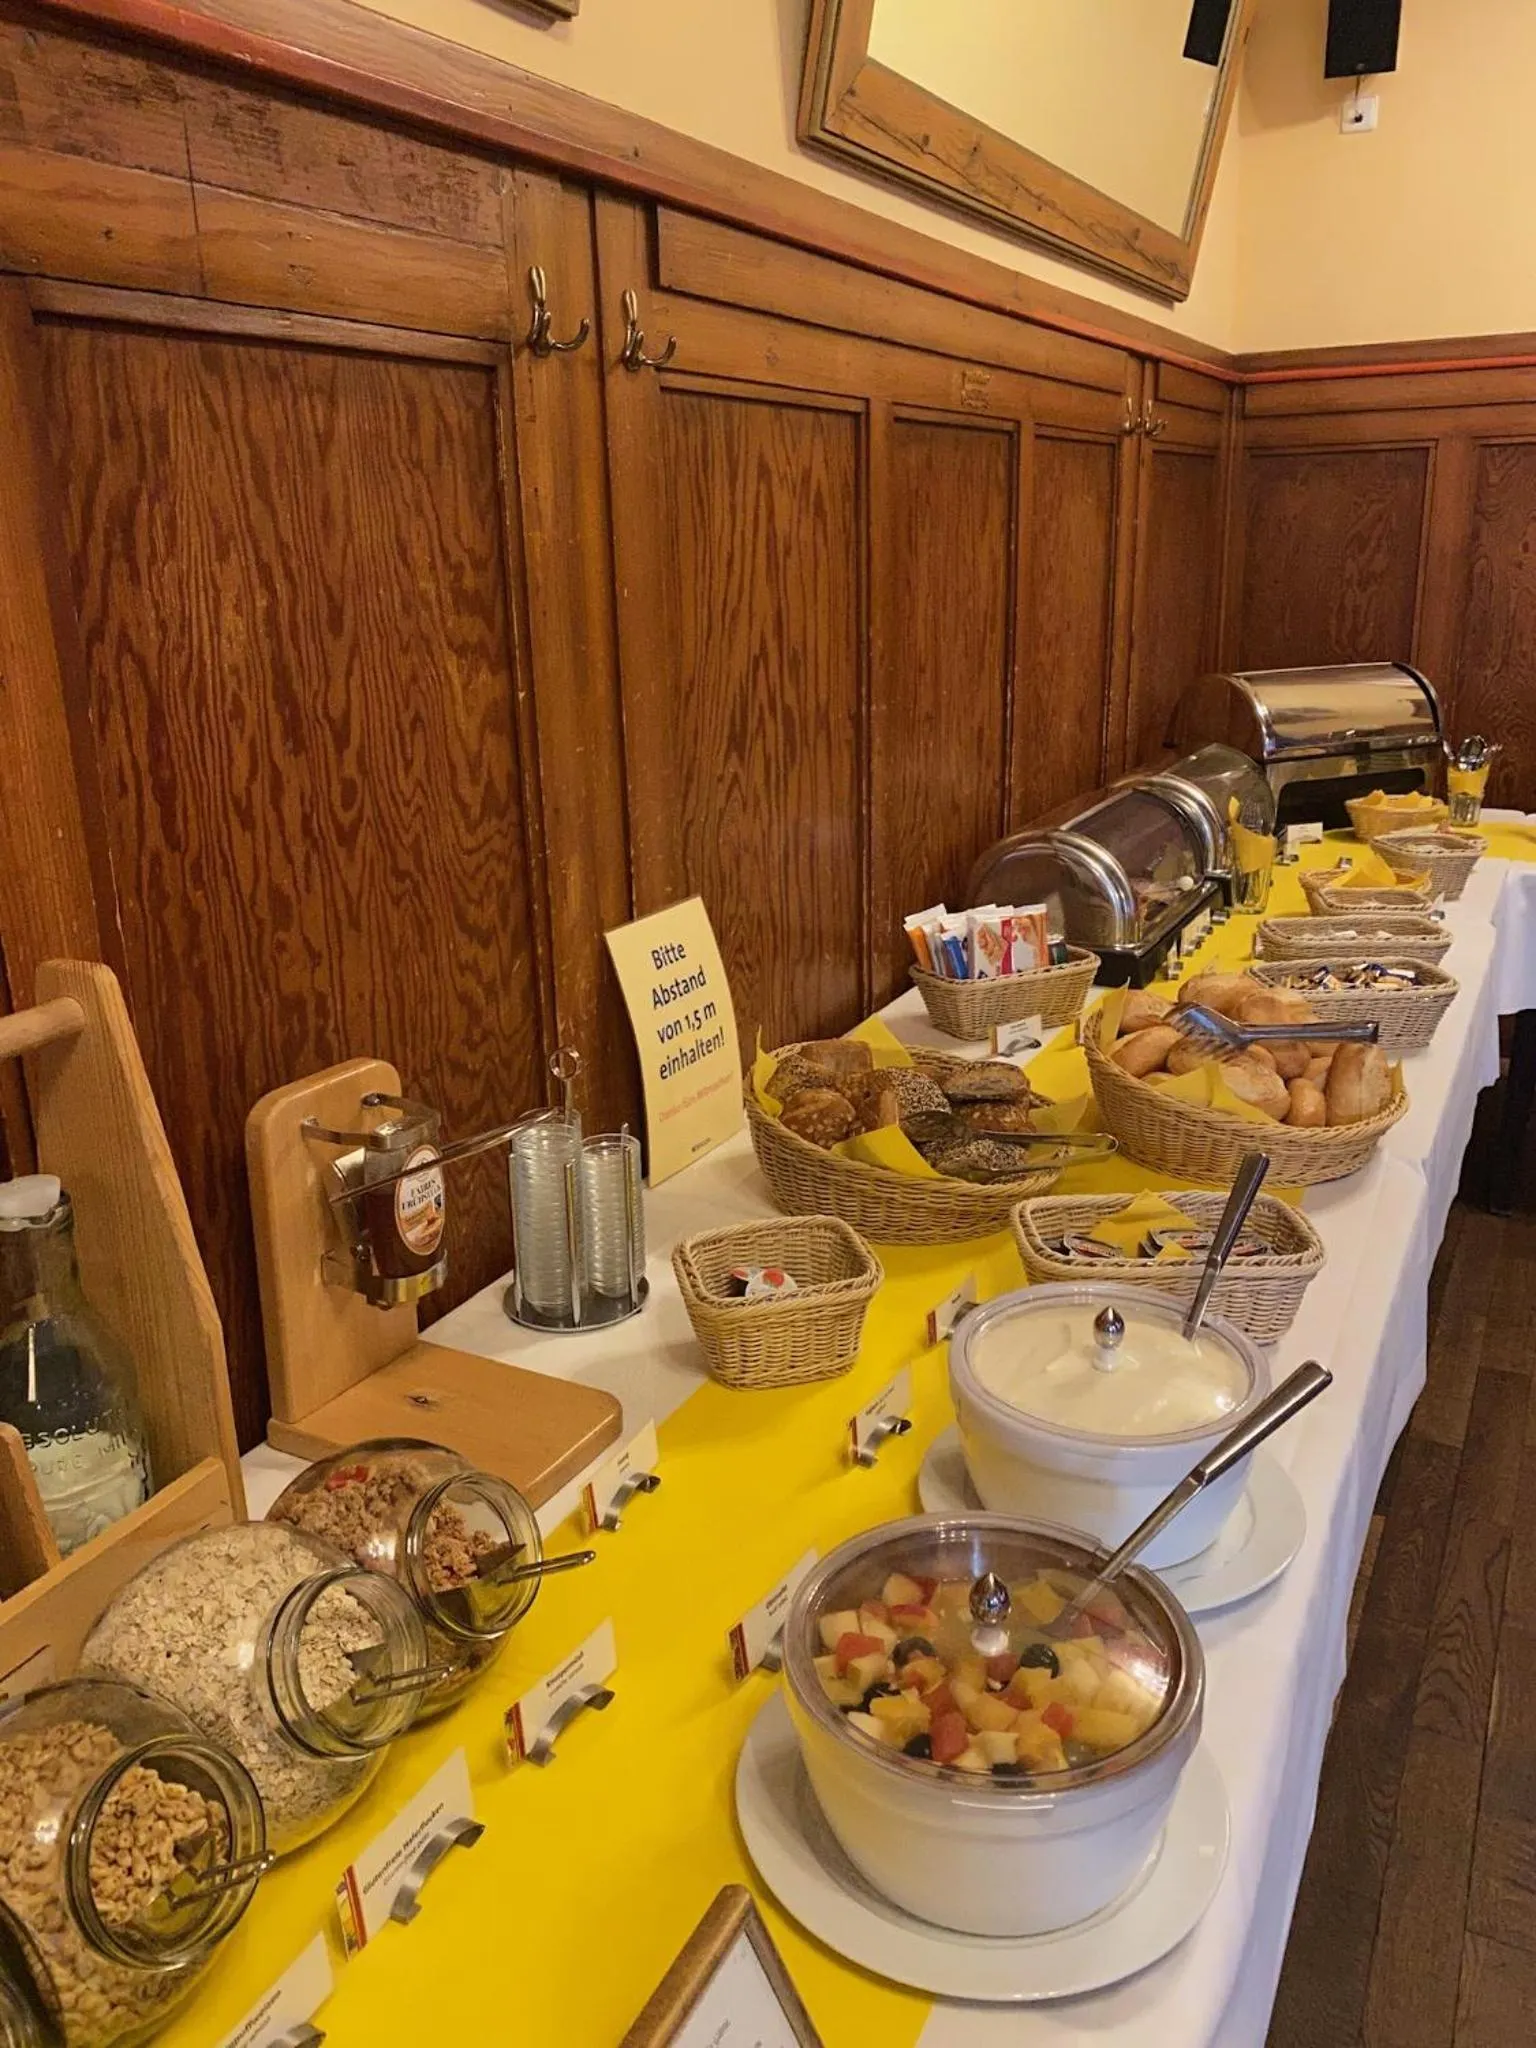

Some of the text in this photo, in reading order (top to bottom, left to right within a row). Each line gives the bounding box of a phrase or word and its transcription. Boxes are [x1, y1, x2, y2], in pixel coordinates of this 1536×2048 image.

[651, 943, 687, 971] Bitte
[651, 964, 707, 1010] Abstand
[657, 1001, 717, 1044] von 1,5 m
[659, 1026, 725, 1080] einhalten!
